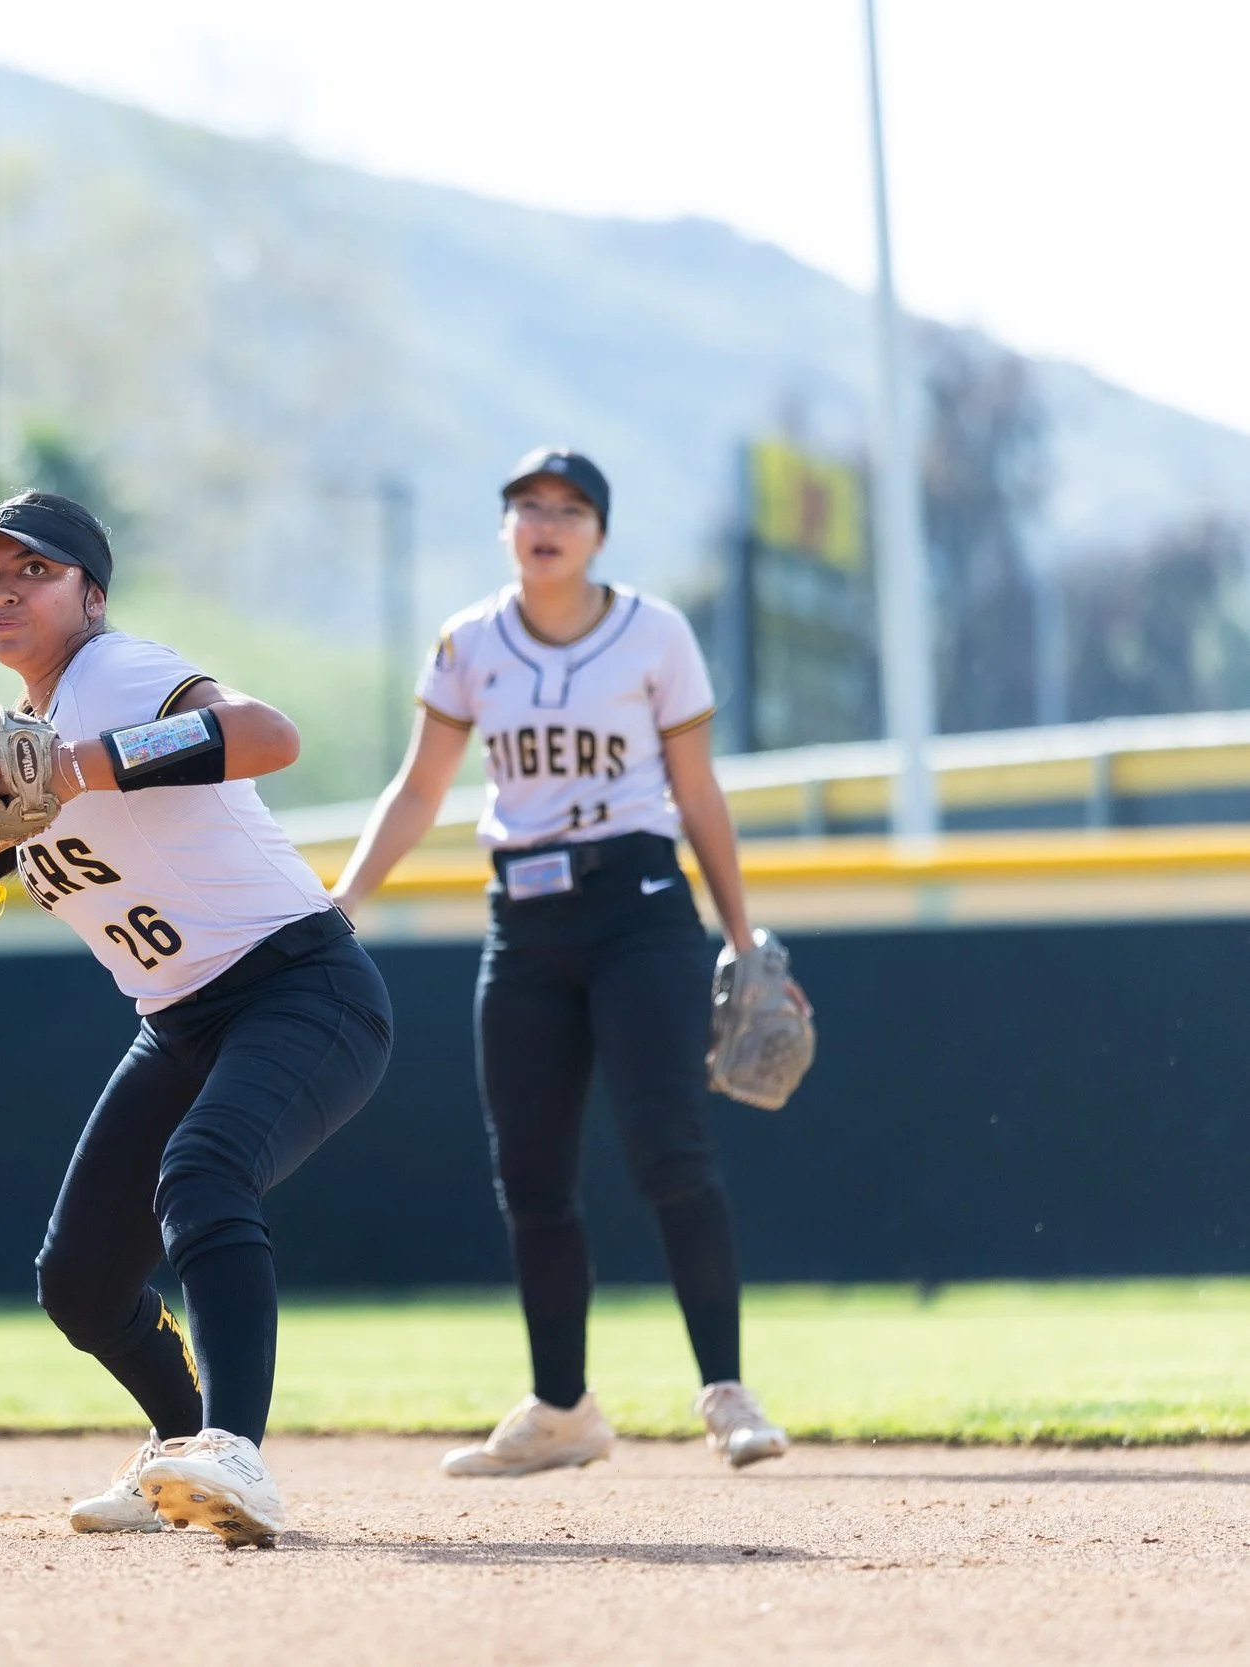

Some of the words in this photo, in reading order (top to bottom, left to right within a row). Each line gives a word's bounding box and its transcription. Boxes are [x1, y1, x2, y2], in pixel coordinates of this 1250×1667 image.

[19, 740, 36, 781] Wilson
[484, 724, 628, 783] TIGERS
[103, 903, 184, 972] 26
